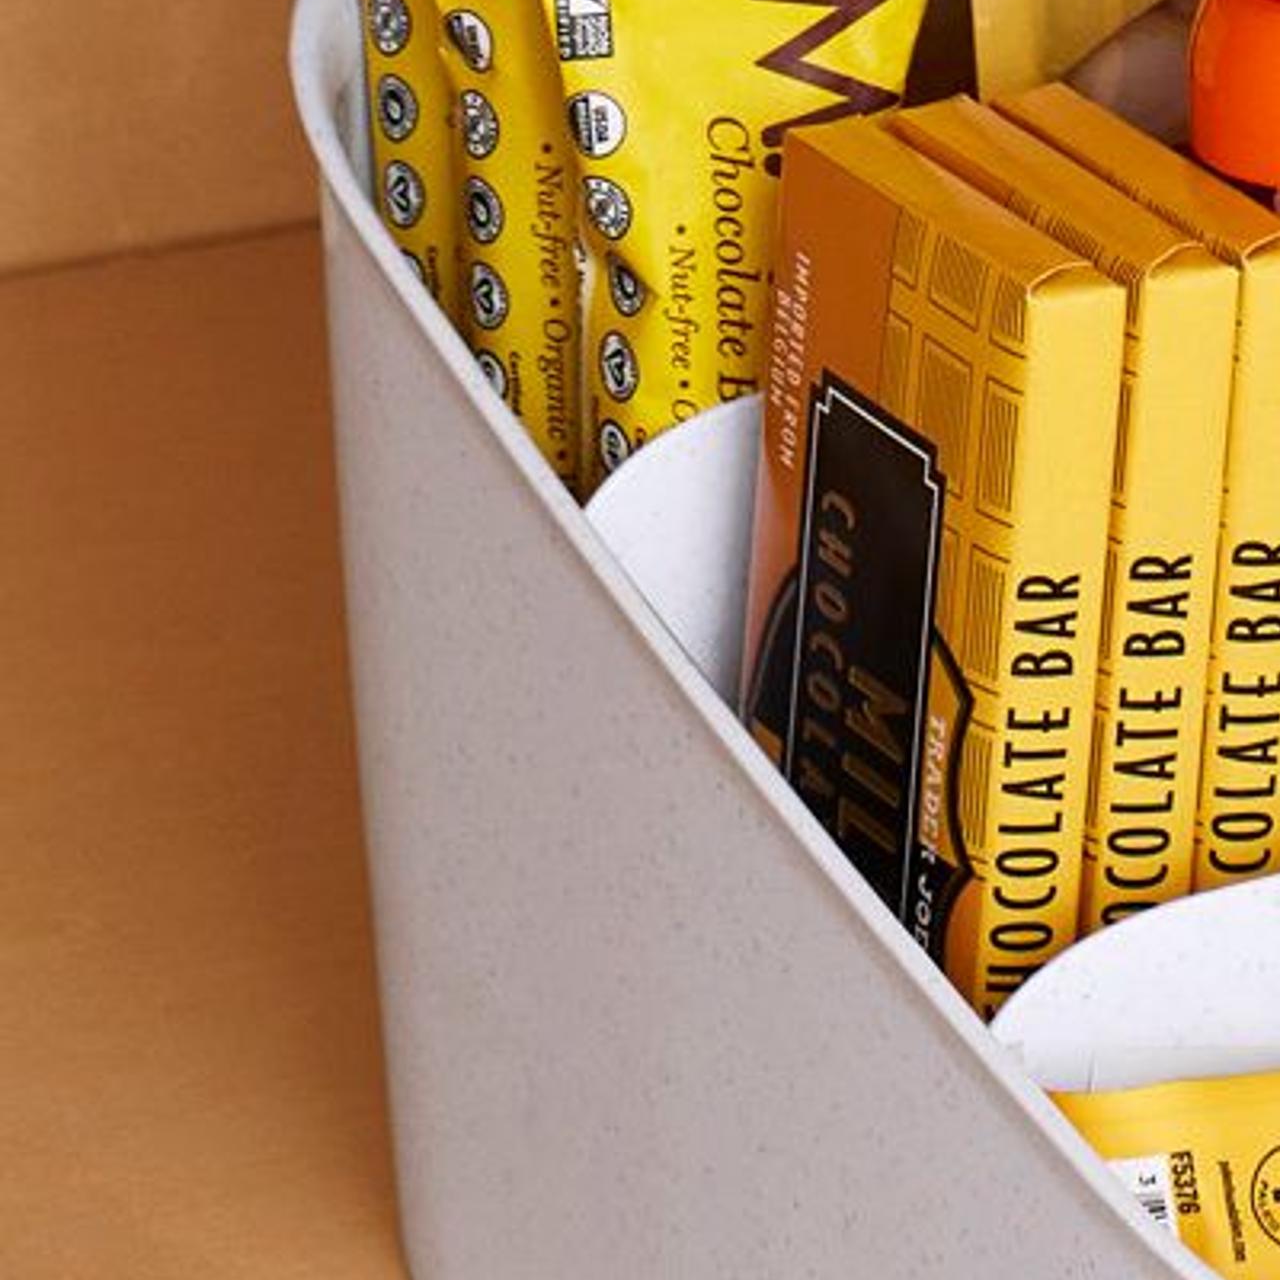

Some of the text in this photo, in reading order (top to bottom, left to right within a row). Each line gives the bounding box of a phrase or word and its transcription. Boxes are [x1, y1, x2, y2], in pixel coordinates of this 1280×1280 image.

[706, 116, 762, 358] Chocolate
[667, 243, 699, 374] Nut-free
[784, 251, 813, 386] IMPORTED
[1012, 571, 1082, 680] BAR
[1123, 552, 1195, 659] BAR
